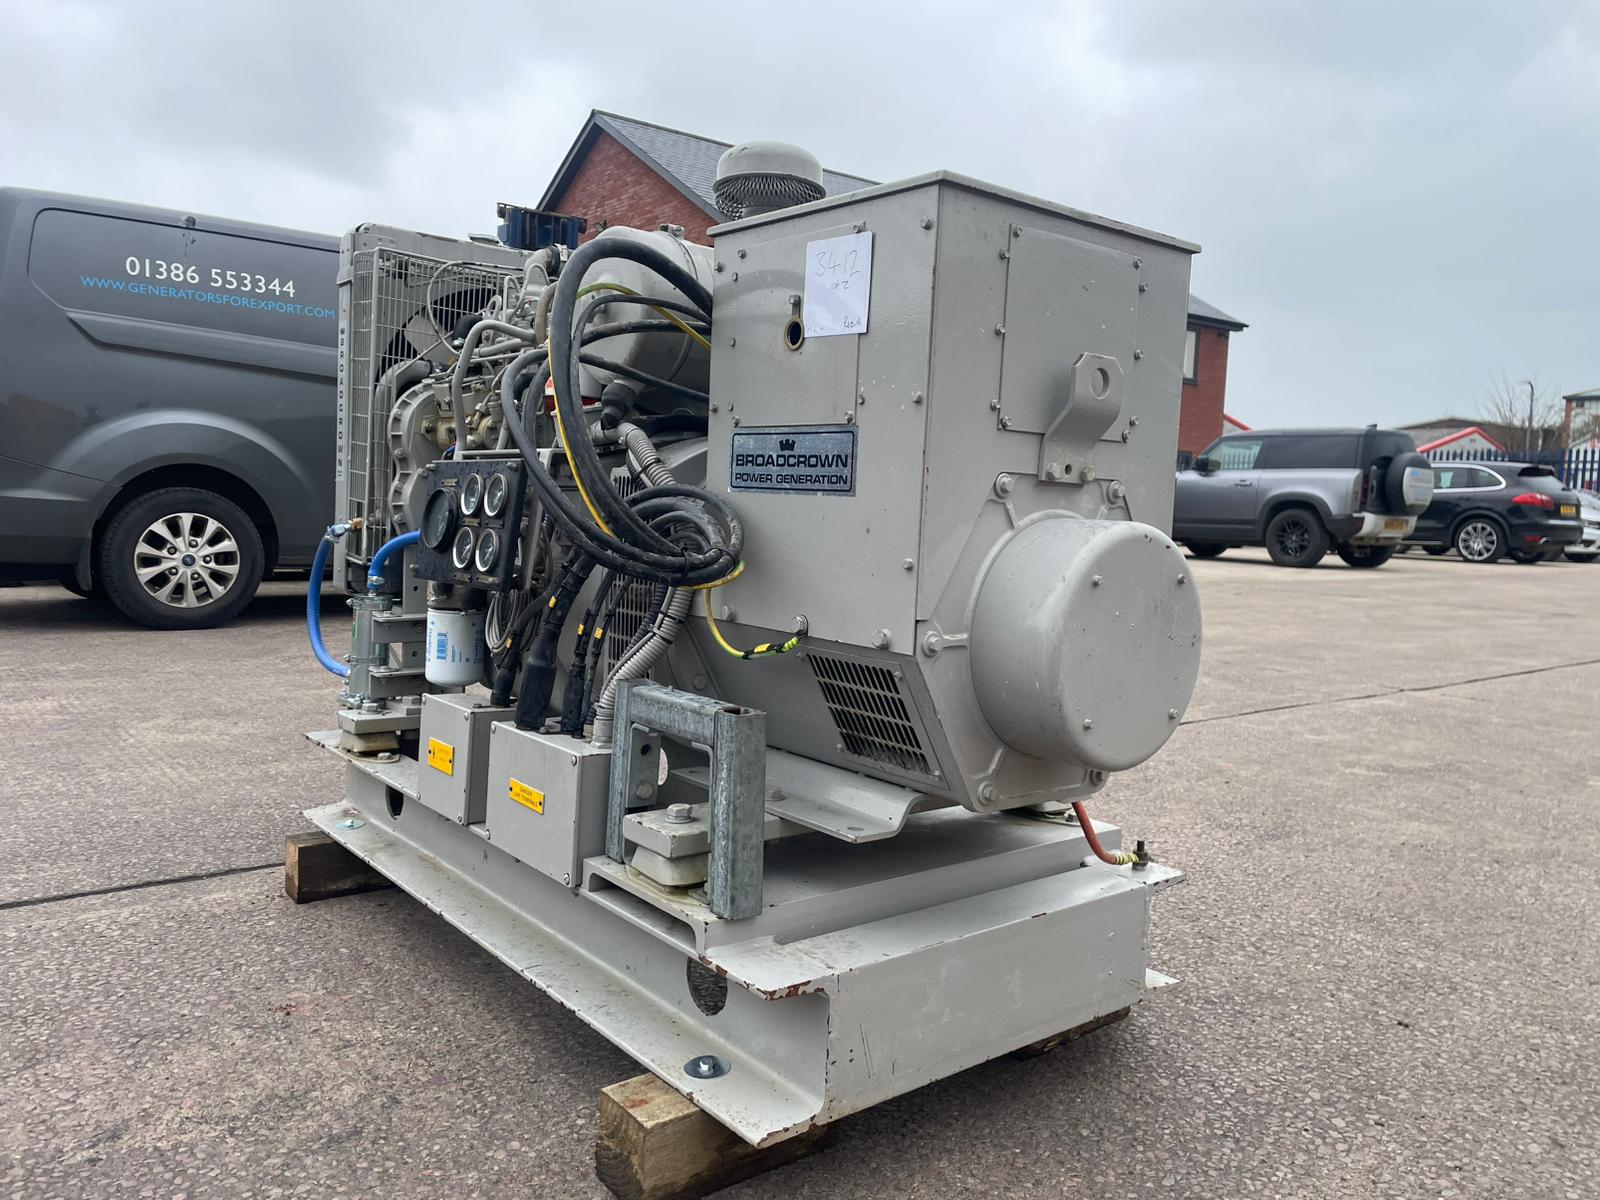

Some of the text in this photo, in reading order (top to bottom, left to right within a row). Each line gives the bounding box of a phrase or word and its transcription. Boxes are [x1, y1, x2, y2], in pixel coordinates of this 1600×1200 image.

[125, 256, 296, 298] 01386 553344
[815, 249, 861, 277] 3412
[80, 275, 336, 319] WWW.GENERATORSFOREXPORT.COM
[337, 337, 345, 467] BROADCROWN
[735, 454, 848, 468] BROADCROWN
[735, 473, 848, 485] POWER GENERATION
